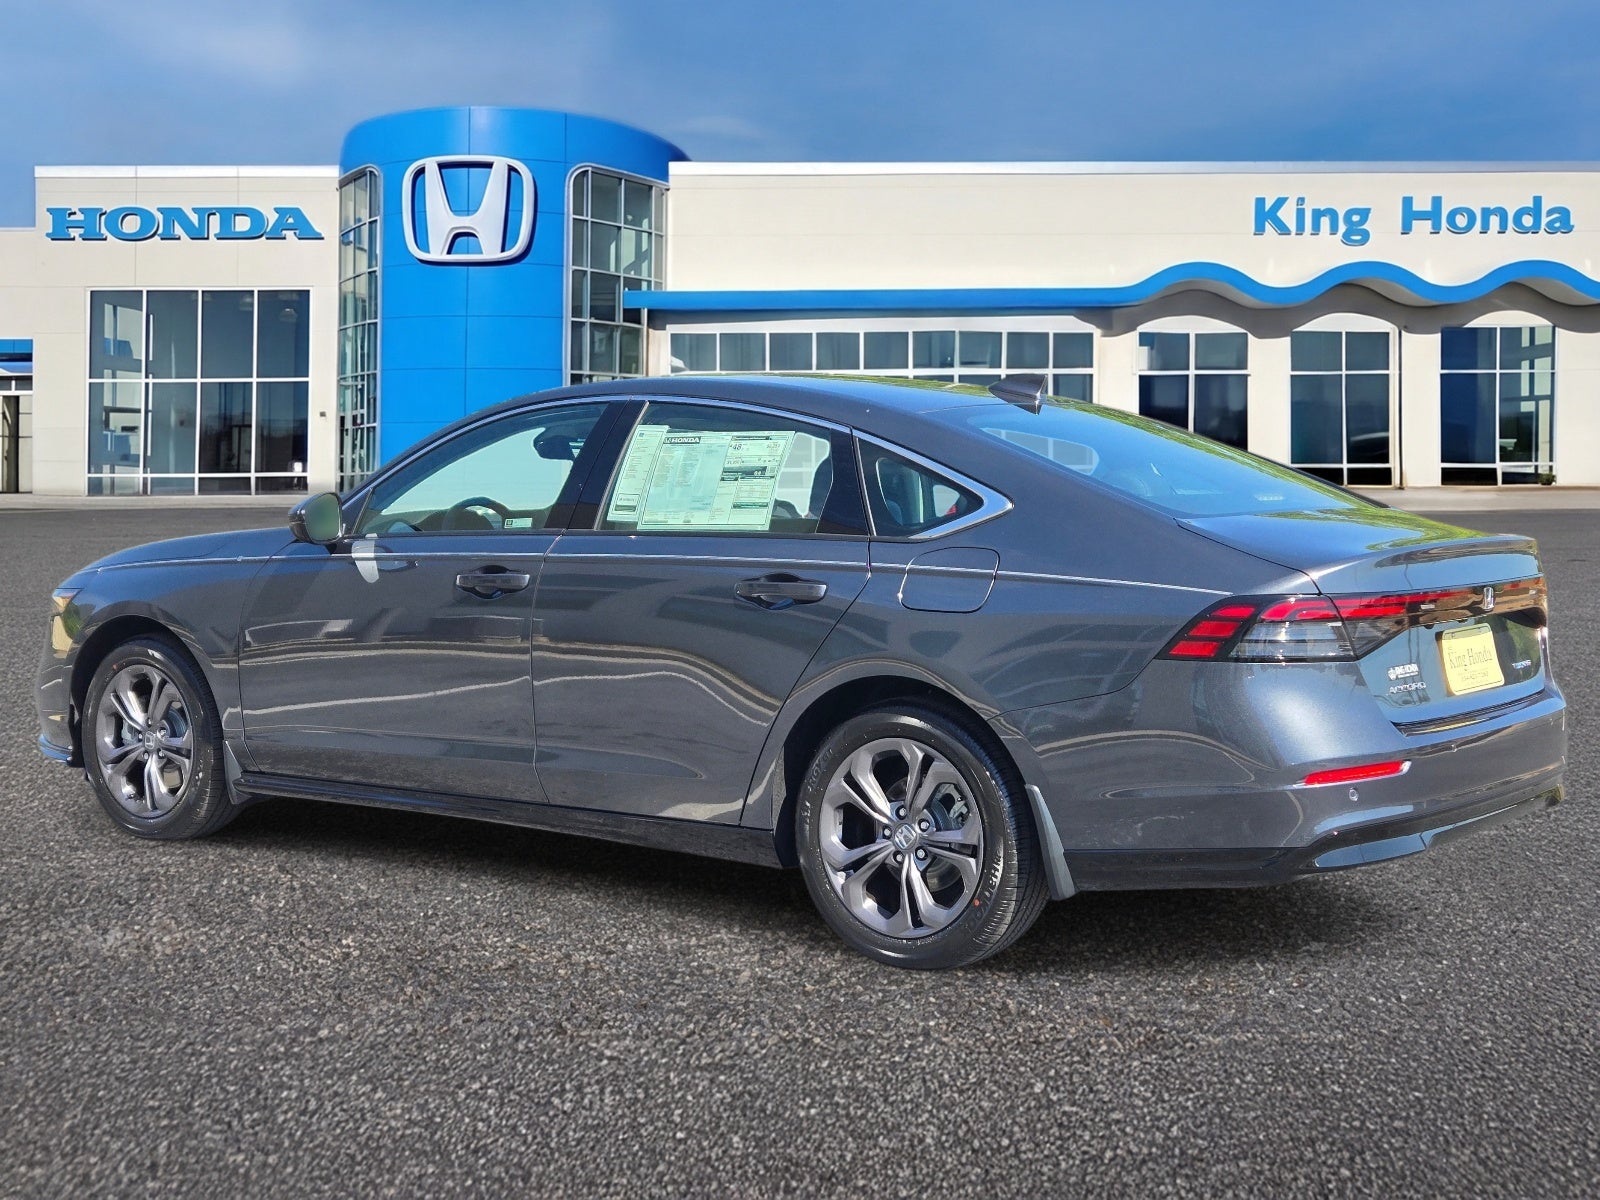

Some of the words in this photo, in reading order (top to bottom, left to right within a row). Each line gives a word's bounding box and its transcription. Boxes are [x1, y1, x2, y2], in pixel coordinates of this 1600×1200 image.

[45, 206, 325, 242] HONDA
[1253, 196, 1372, 247] King
[1400, 195, 1575, 236] Honda
[1467, 645, 1493, 666] Honda
